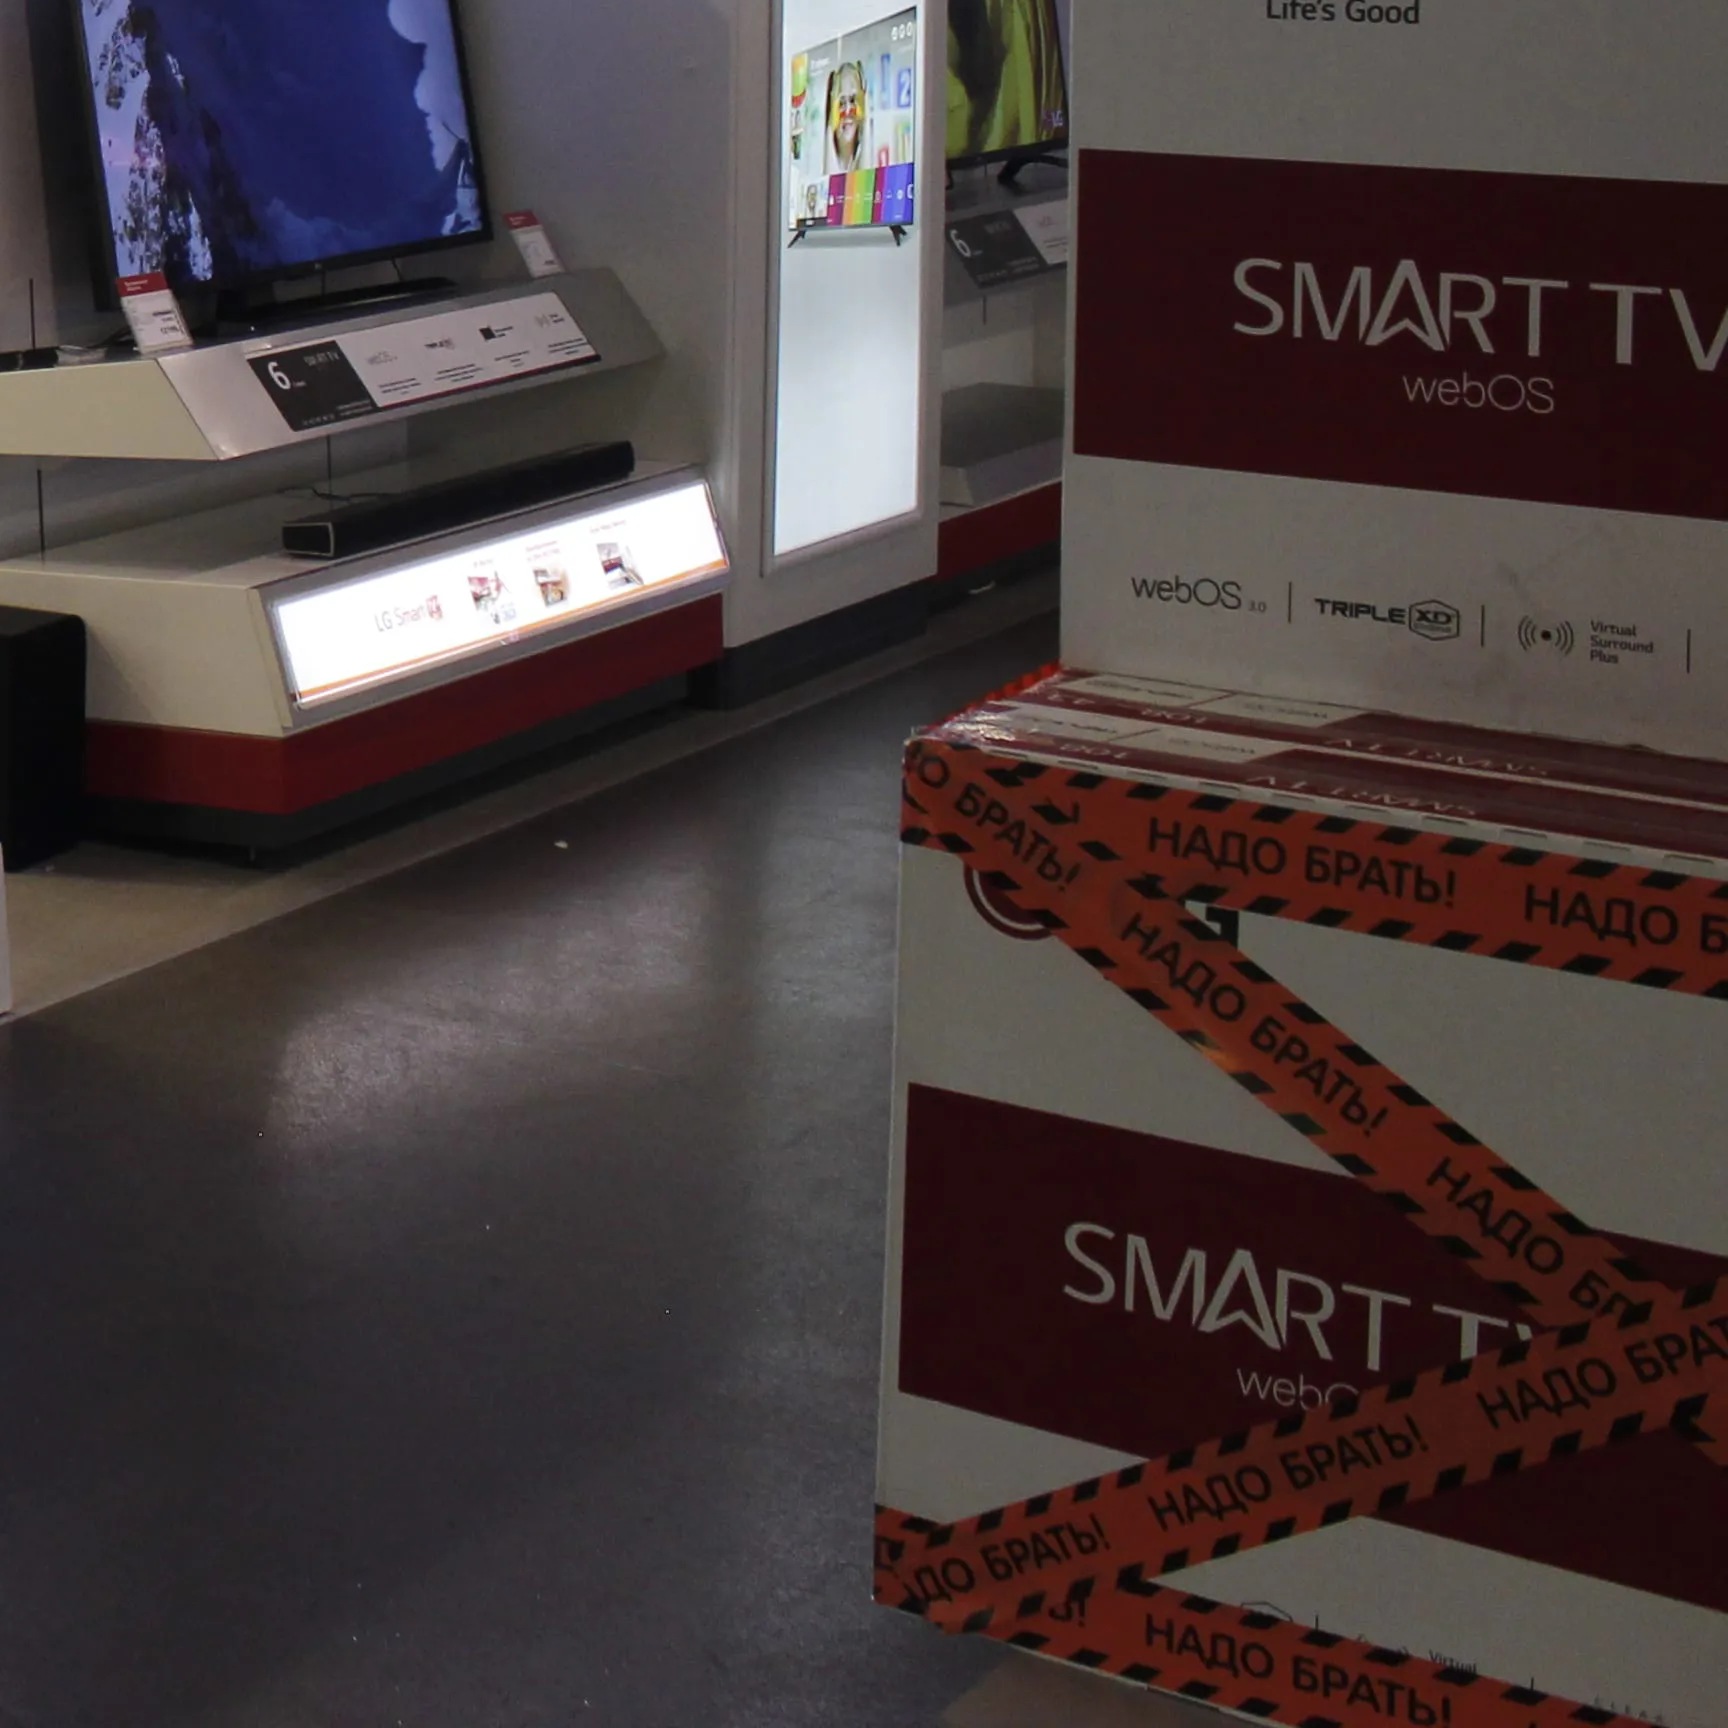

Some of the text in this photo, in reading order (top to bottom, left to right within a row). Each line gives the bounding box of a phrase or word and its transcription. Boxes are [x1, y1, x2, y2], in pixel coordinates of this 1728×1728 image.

[1233, 256, 1728, 372] SMART TV
[267, 361, 292, 390] 6
[1402, 371, 1556, 414] webOS
[1130, 575, 1243, 611] webOS
[1314, 597, 1452, 625] TRIPLE XD
[1589, 620, 1637, 637] Virtual
[1589, 635, 1655, 654] Surround
[1589, 648, 1619, 665] Plus
[955, 781, 1081, 892] БРАТЬ!
[1149, 816, 1457, 908] НАДО БРАТЬ!
[1524, 884, 1681, 948] НАДО
[1121, 912, 1390, 1138] НАДО БРАТЬ!
[1426, 1155, 1566, 1275] НАДО
[1061, 1221, 1413, 1372] SMART
[1475, 1357, 1618, 1430] НАДО
[1148, 1414, 1431, 1533] НАДО БРАТЬ!
[979, 1512, 1112, 1582] БРАТЬ!
[1145, 1612, 1452, 1728] НАДО БРАТЬ!
